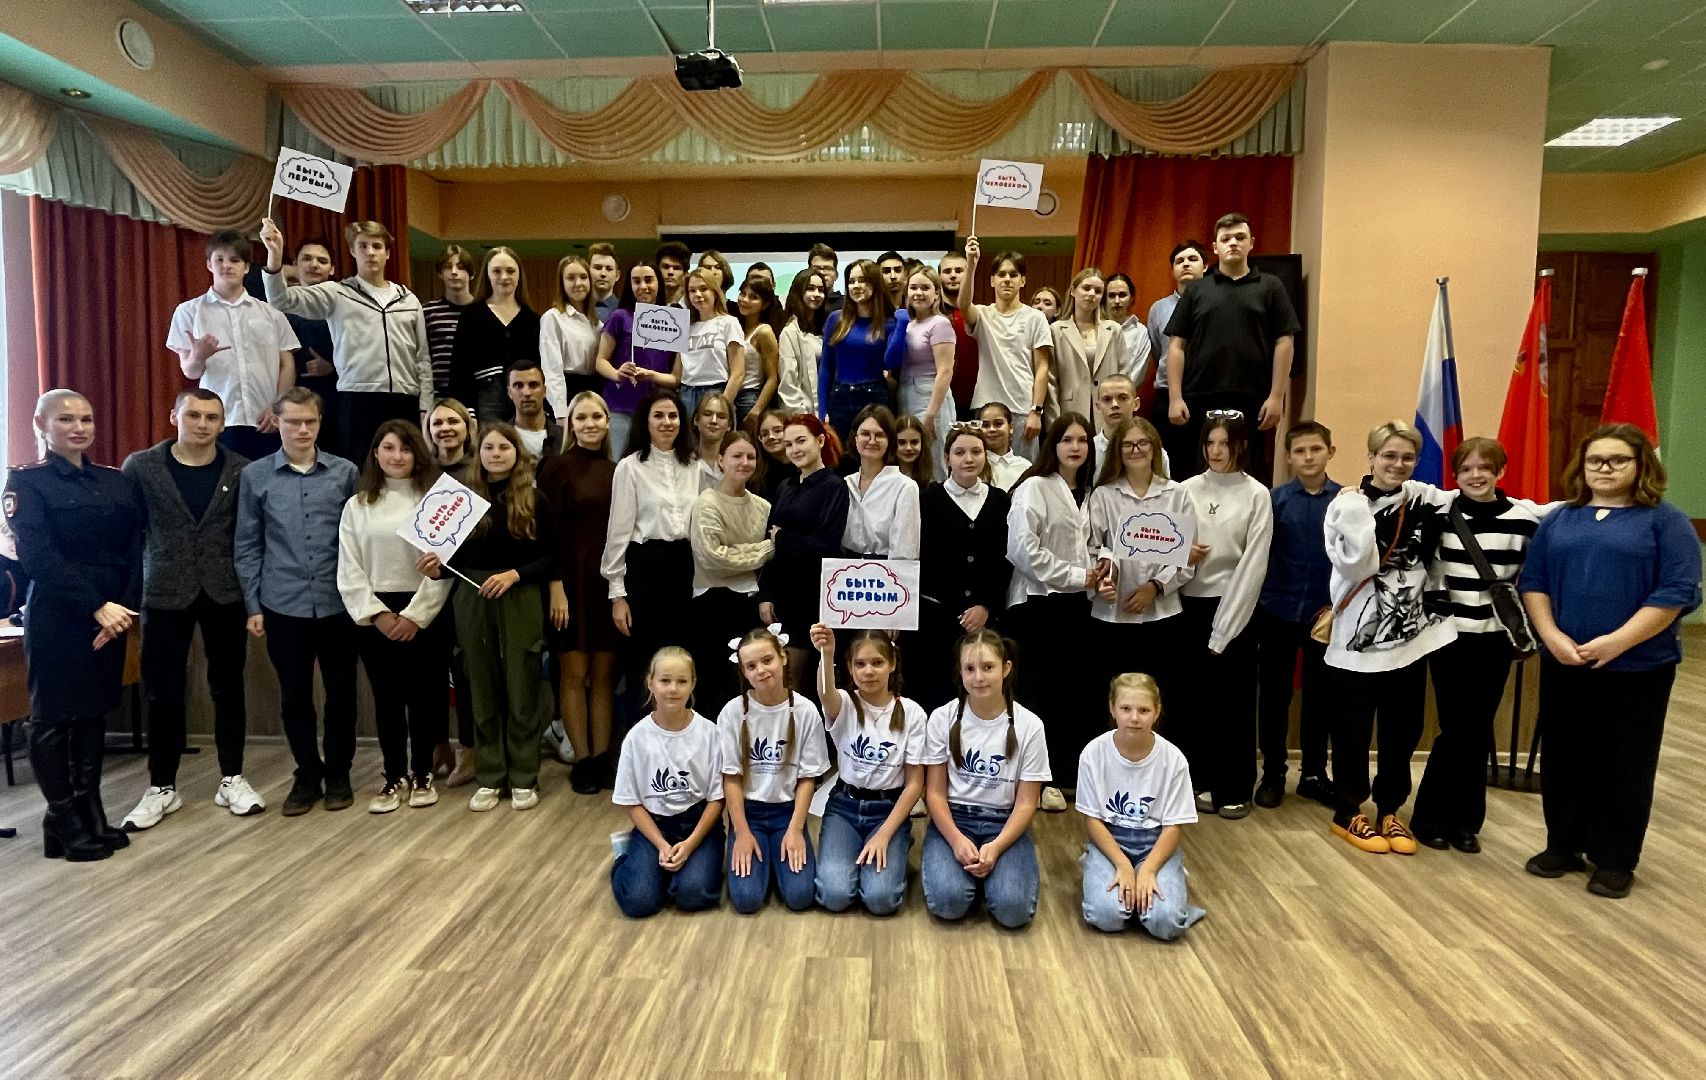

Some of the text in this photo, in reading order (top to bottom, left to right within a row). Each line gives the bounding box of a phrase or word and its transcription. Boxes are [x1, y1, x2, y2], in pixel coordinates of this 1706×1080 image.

[296, 164, 325, 179] БЫТЬ
[288, 171, 333, 190] ПЕРВЫМ
[985, 181, 1028, 189] ЧЕЛОВЕКОМ
[640, 323, 678, 333] ЧЕЛОВЕКОМ
[651, 318, 669, 326] БЫТЬ
[429, 504, 448, 525] БЫТЬ
[434, 495, 464, 532] РОССИЕЙ
[1140, 526, 1160, 534] БЫТЬ
[1133, 532, 1176, 543] ДВИЖЕНИИ
[845, 577, 886, 589] БЫТЬ
[837, 590, 899, 603] ПЕРВЫМ
